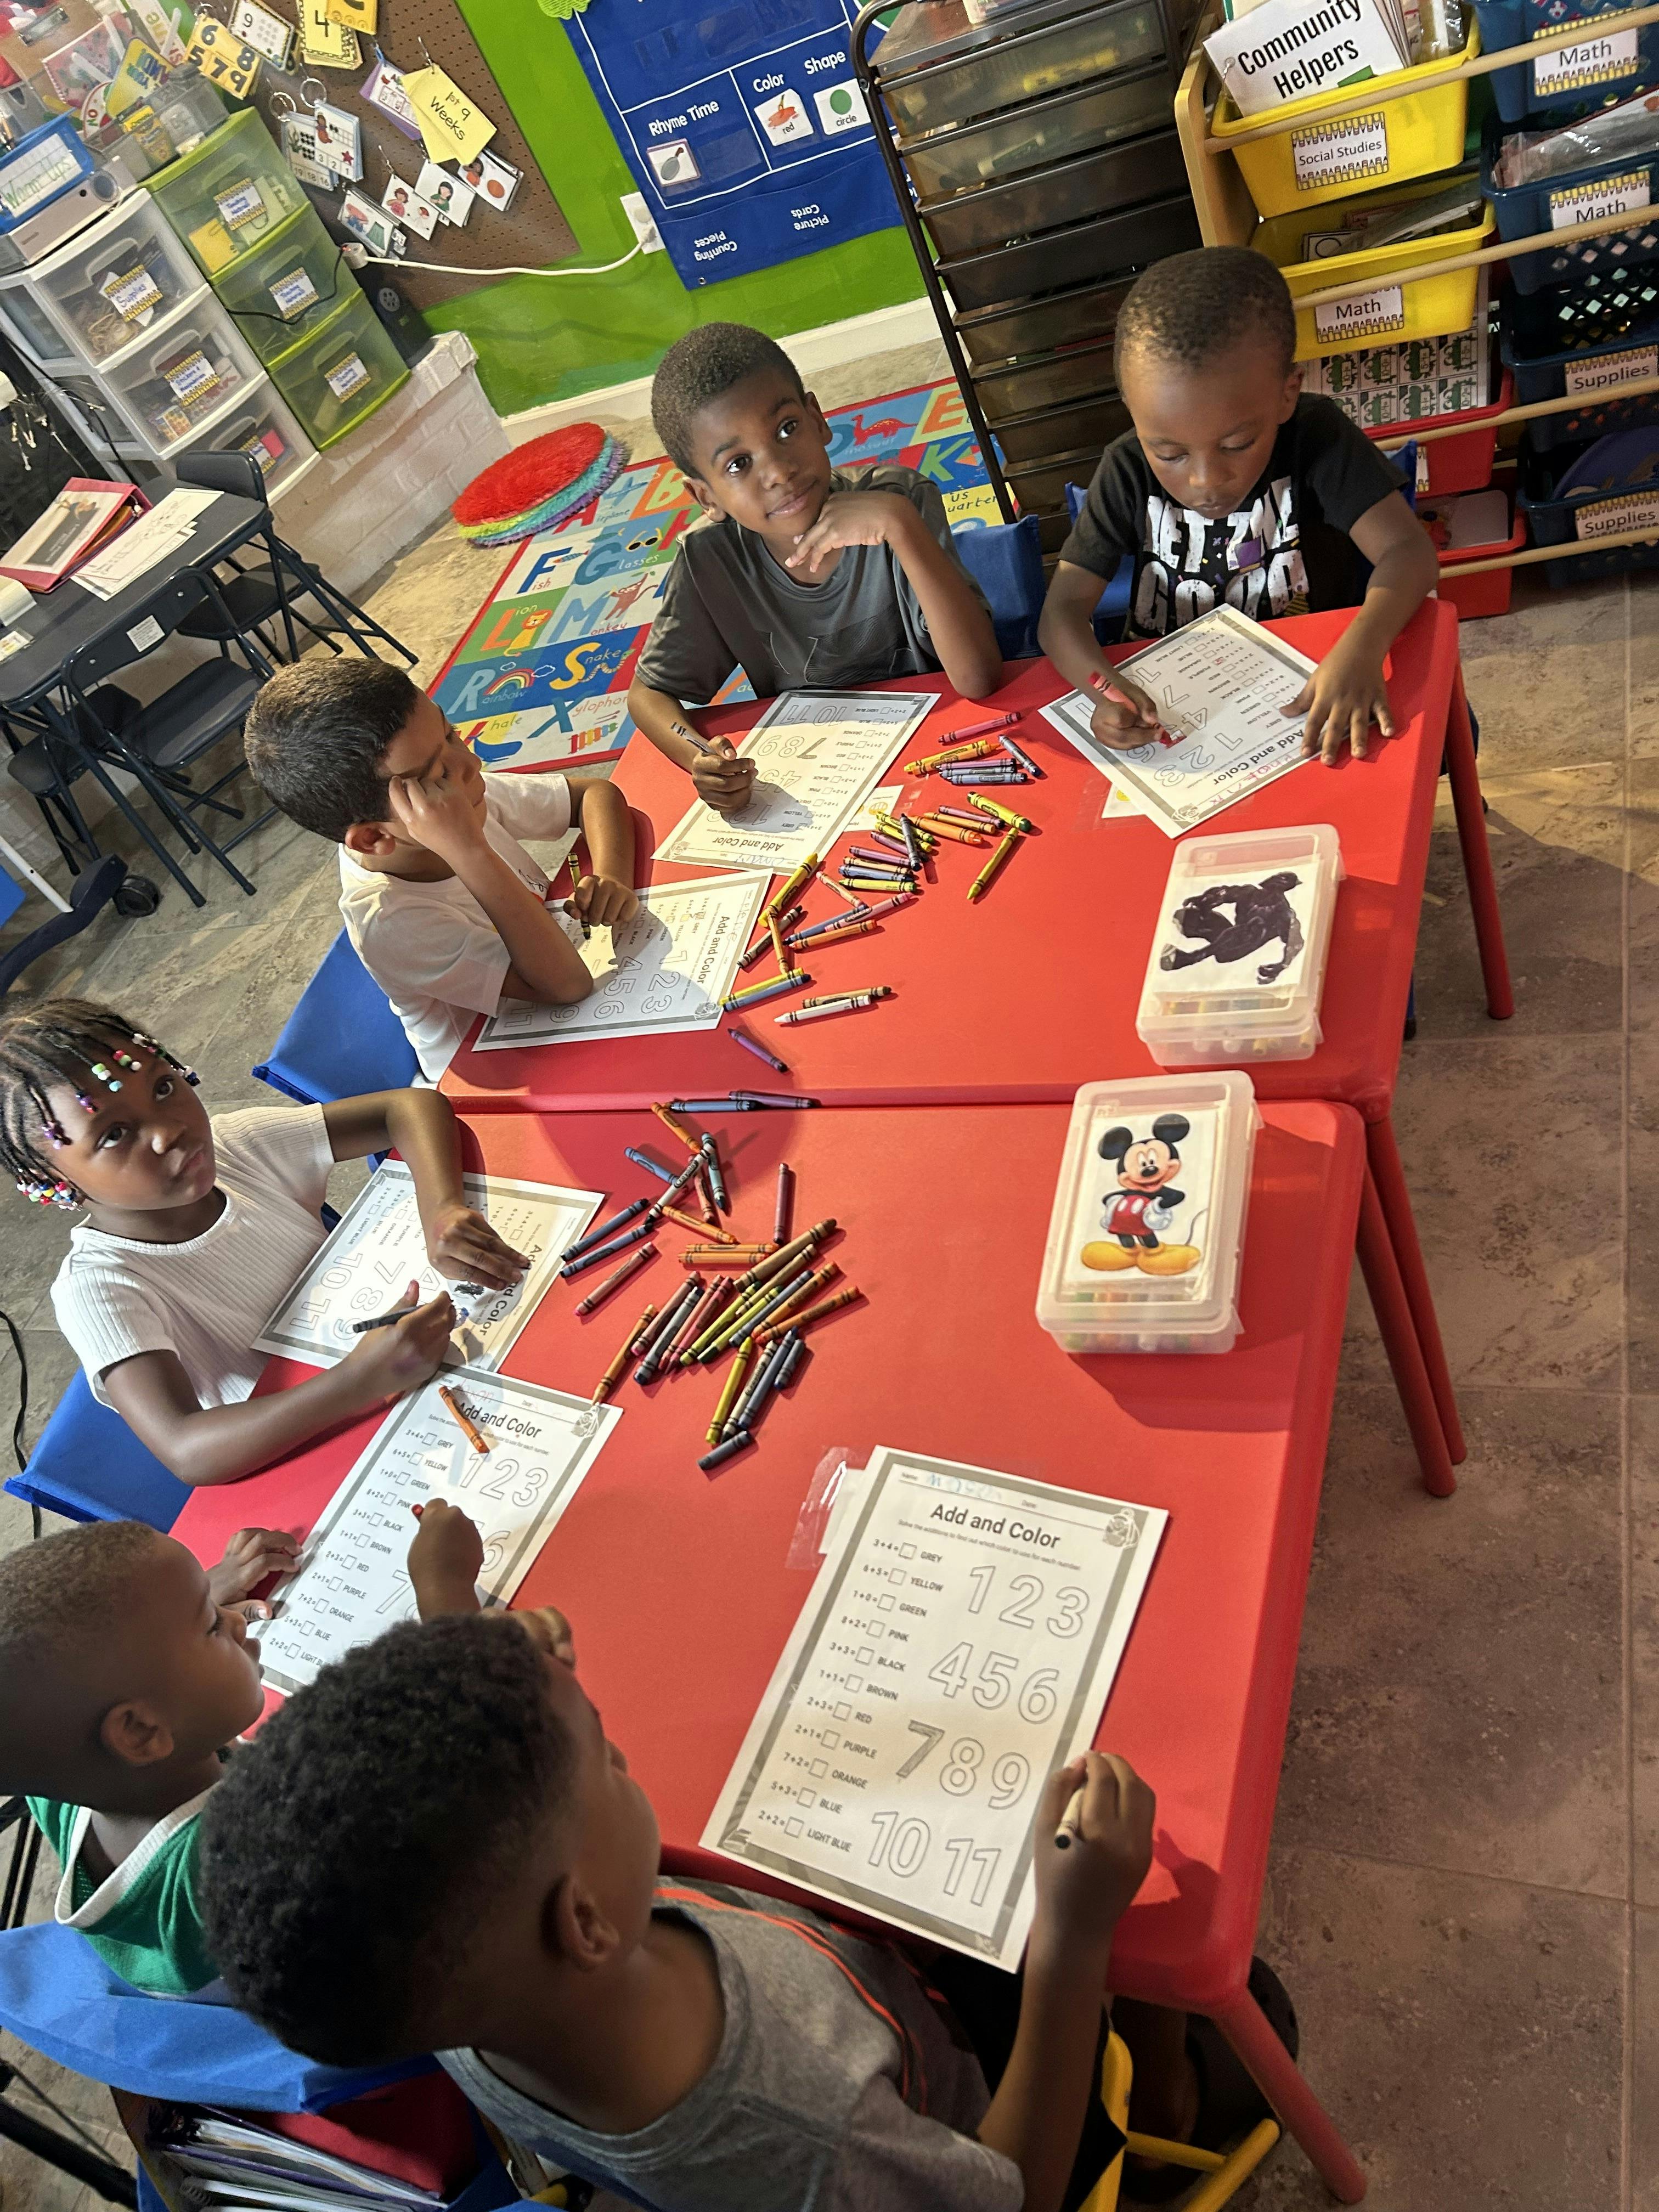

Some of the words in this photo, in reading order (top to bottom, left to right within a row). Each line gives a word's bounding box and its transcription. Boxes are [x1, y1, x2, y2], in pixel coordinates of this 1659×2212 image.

[315, 10, 330, 37] 4
[201, 25, 219, 46] 6
[237, 46, 256, 71] 8
[1238, 0, 1362, 76] Community
[804, 51, 846, 75] Shape
[1559, 40, 1612, 67] Math
[188, 45, 206, 67] 5
[210, 59, 229, 79] 7
[230, 71, 248, 93] 9
[1273, 38, 1359, 99] Helpers
[753, 72, 785, 93] Color
[431, 95, 466, 140] Weeks
[648, 115, 688, 136] Rhyme
[687, 100, 719, 122] Time
[836, 114, 857, 127] circle
[782, 123, 795, 134] red
[1299, 152, 1333, 166] Social
[1338, 139, 1382, 157] Studies
[319, 153, 324, 162] 3
[331, 160, 337, 170] 2
[345, 167, 349, 175] 1
[791, 204, 820, 218] Cards
[1576, 200, 1626, 223] Math
[794, 215, 830, 230] Picture
[695, 230, 726, 247] Pieces
[694, 240, 737, 261] Counting
[1335, 298, 1382, 320] Math
[1573, 362, 1650, 392] Supplies
[1584, 510, 1656, 535] Supplies
[1164, 685, 1189, 709] 7
[1182, 707, 1207, 730] 4
[758, 735, 782, 756] 9
[778, 736, 805, 758] 8
[797, 737, 827, 759] 7
[1250, 746, 1276, 764] and
[1180, 745, 1215, 769] 2
[1154, 764, 1185, 787] 3
[1214, 761, 1250, 785] Color
[713, 837, 738, 847] Color
[741, 839, 761, 849] and
[761, 842, 784, 851] Add
[715, 916, 730, 935] Add
[708, 938, 722, 955] and
[611, 956, 642, 975] 4
[697, 958, 714, 984] Color
[604, 978, 636, 996] 5
[648, 972, 680, 991] 2
[594, 1001, 624, 1019] 6
[641, 995, 672, 1014] 3
[320, 1253, 363, 1289] 10
[374, 1261, 406, 1284] 7
[351, 1288, 383, 1311] 8
[479, 1300, 507, 1335] Color
[481, 1414, 507, 1427] and
[506, 1418, 541, 1438] Color
[437, 1439, 454, 1449] GREY
[424, 1459, 449, 1471] YELLOW
[411, 1479, 431, 1491] GREEN
[460, 1451, 489, 1488] 1
[480, 1458, 519, 1500] 2
[512, 1467, 549, 1507] 3
[397, 1499, 412, 1509] PINK
[383, 1520, 404, 1532] BLACK
[930, 1503, 969, 1526] Add
[970, 1514, 1006, 1535] and
[1009, 1521, 1061, 1549] Color
[370, 1542, 392, 1555] BROWN
[921, 1550, 943, 1564] GREY
[357, 1563, 369, 1573] RED
[343, 1584, 366, 1600] PURPLE
[910, 1576, 944, 1593] YELLOW
[899, 1602, 928, 1617] GREEN
[968, 1565, 996, 1614] 1
[998, 1574, 1044, 1629] 2
[1046, 1586, 1091, 1639] 3
[329, 1607, 354, 1622] ORANGE
[315, 1629, 332, 1640] BLUE
[888, 1629, 910, 1641] PINK
[877, 1656, 906, 1672] BLACK
[866, 1684, 899, 1701] BROWN
[928, 1641, 973, 1699] 4
[972, 1651, 1019, 1710] 5
[1018, 1668, 1060, 1724] 6
[855, 1711, 872, 1724] RED
[843, 1740, 877, 1759] PURPLE
[896, 1718, 945, 1779] 7
[939, 1737, 984, 1797] 8
[988, 1752, 1030, 1810] 9
[832, 1769, 868, 1790] ORANGE
[820, 1798, 843, 1814] BLUE
[807, 1828, 831, 1843] LIGHT
[831, 1837, 853, 1852] BLUE
[868, 1811, 931, 1877] 10
[943, 1837, 1002, 1907] 11
